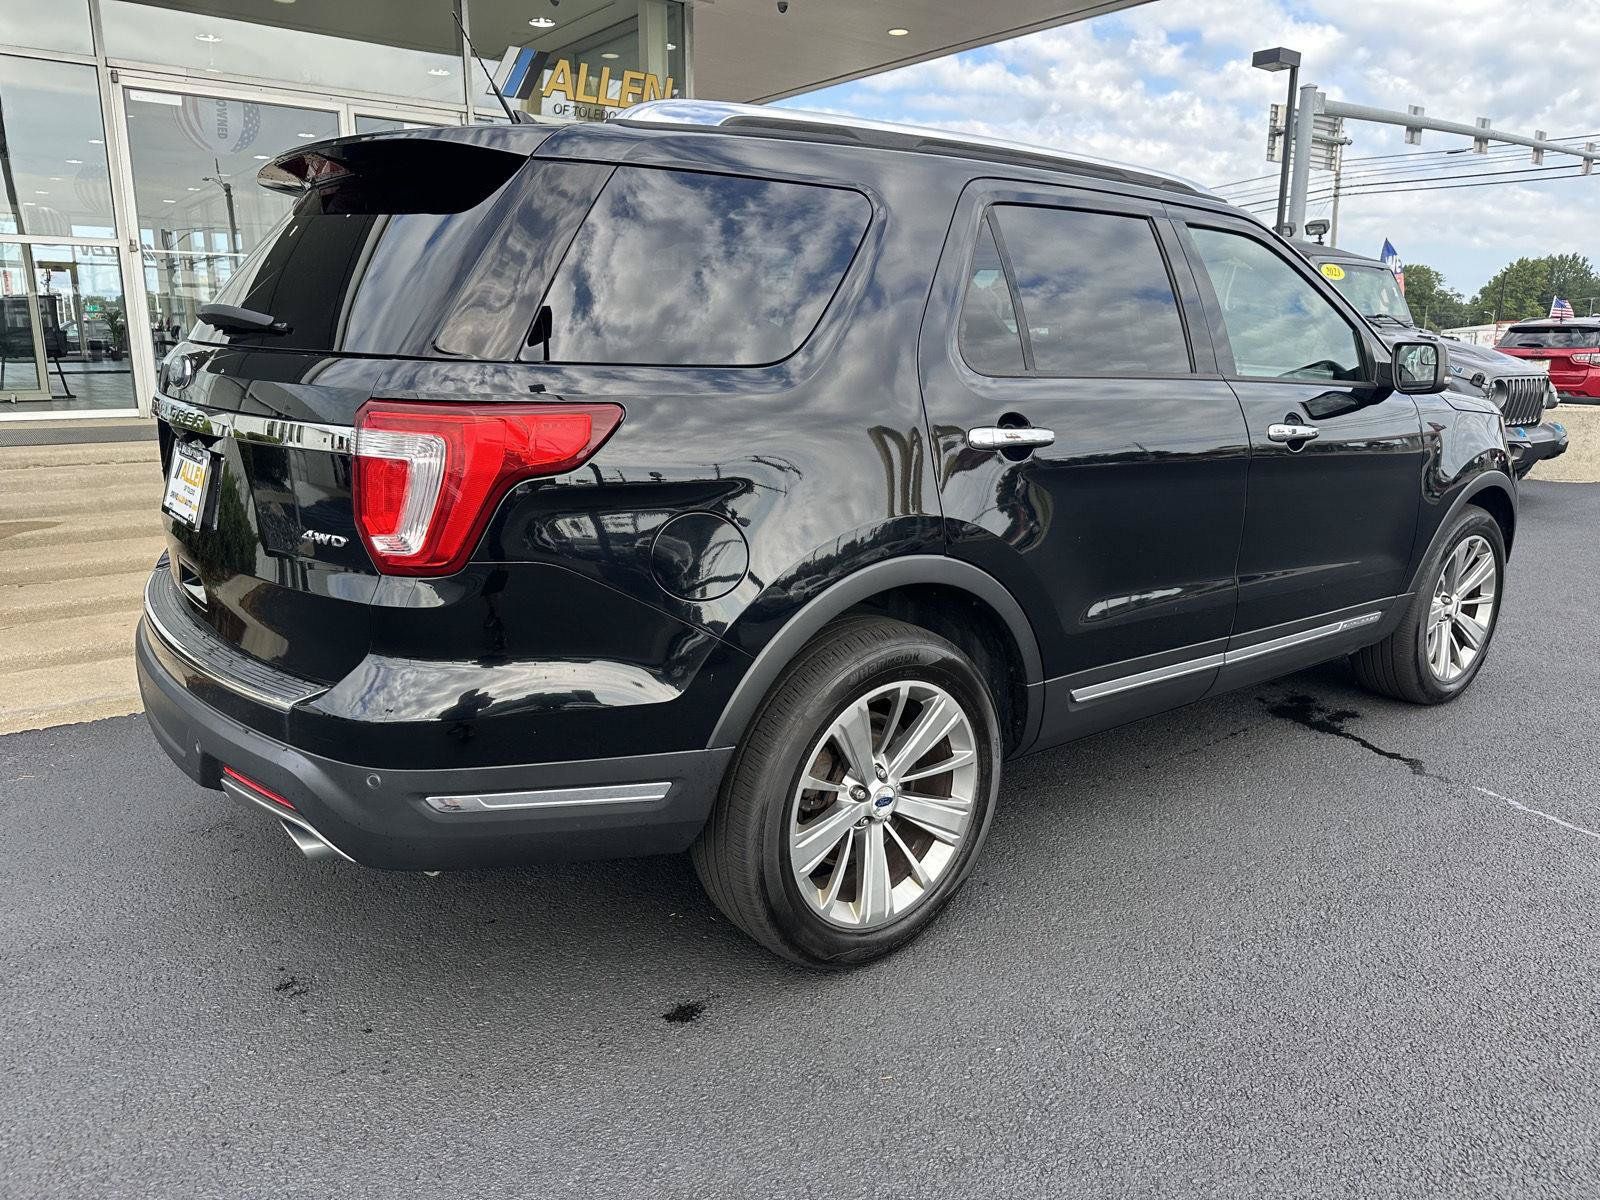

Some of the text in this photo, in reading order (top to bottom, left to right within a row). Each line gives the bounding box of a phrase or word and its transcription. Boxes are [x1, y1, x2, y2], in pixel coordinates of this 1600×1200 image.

[542, 58, 674, 108] ALLEN
[553, 103, 617, 121] OF TOLEDO
[301, 529, 348, 547] 4WD
